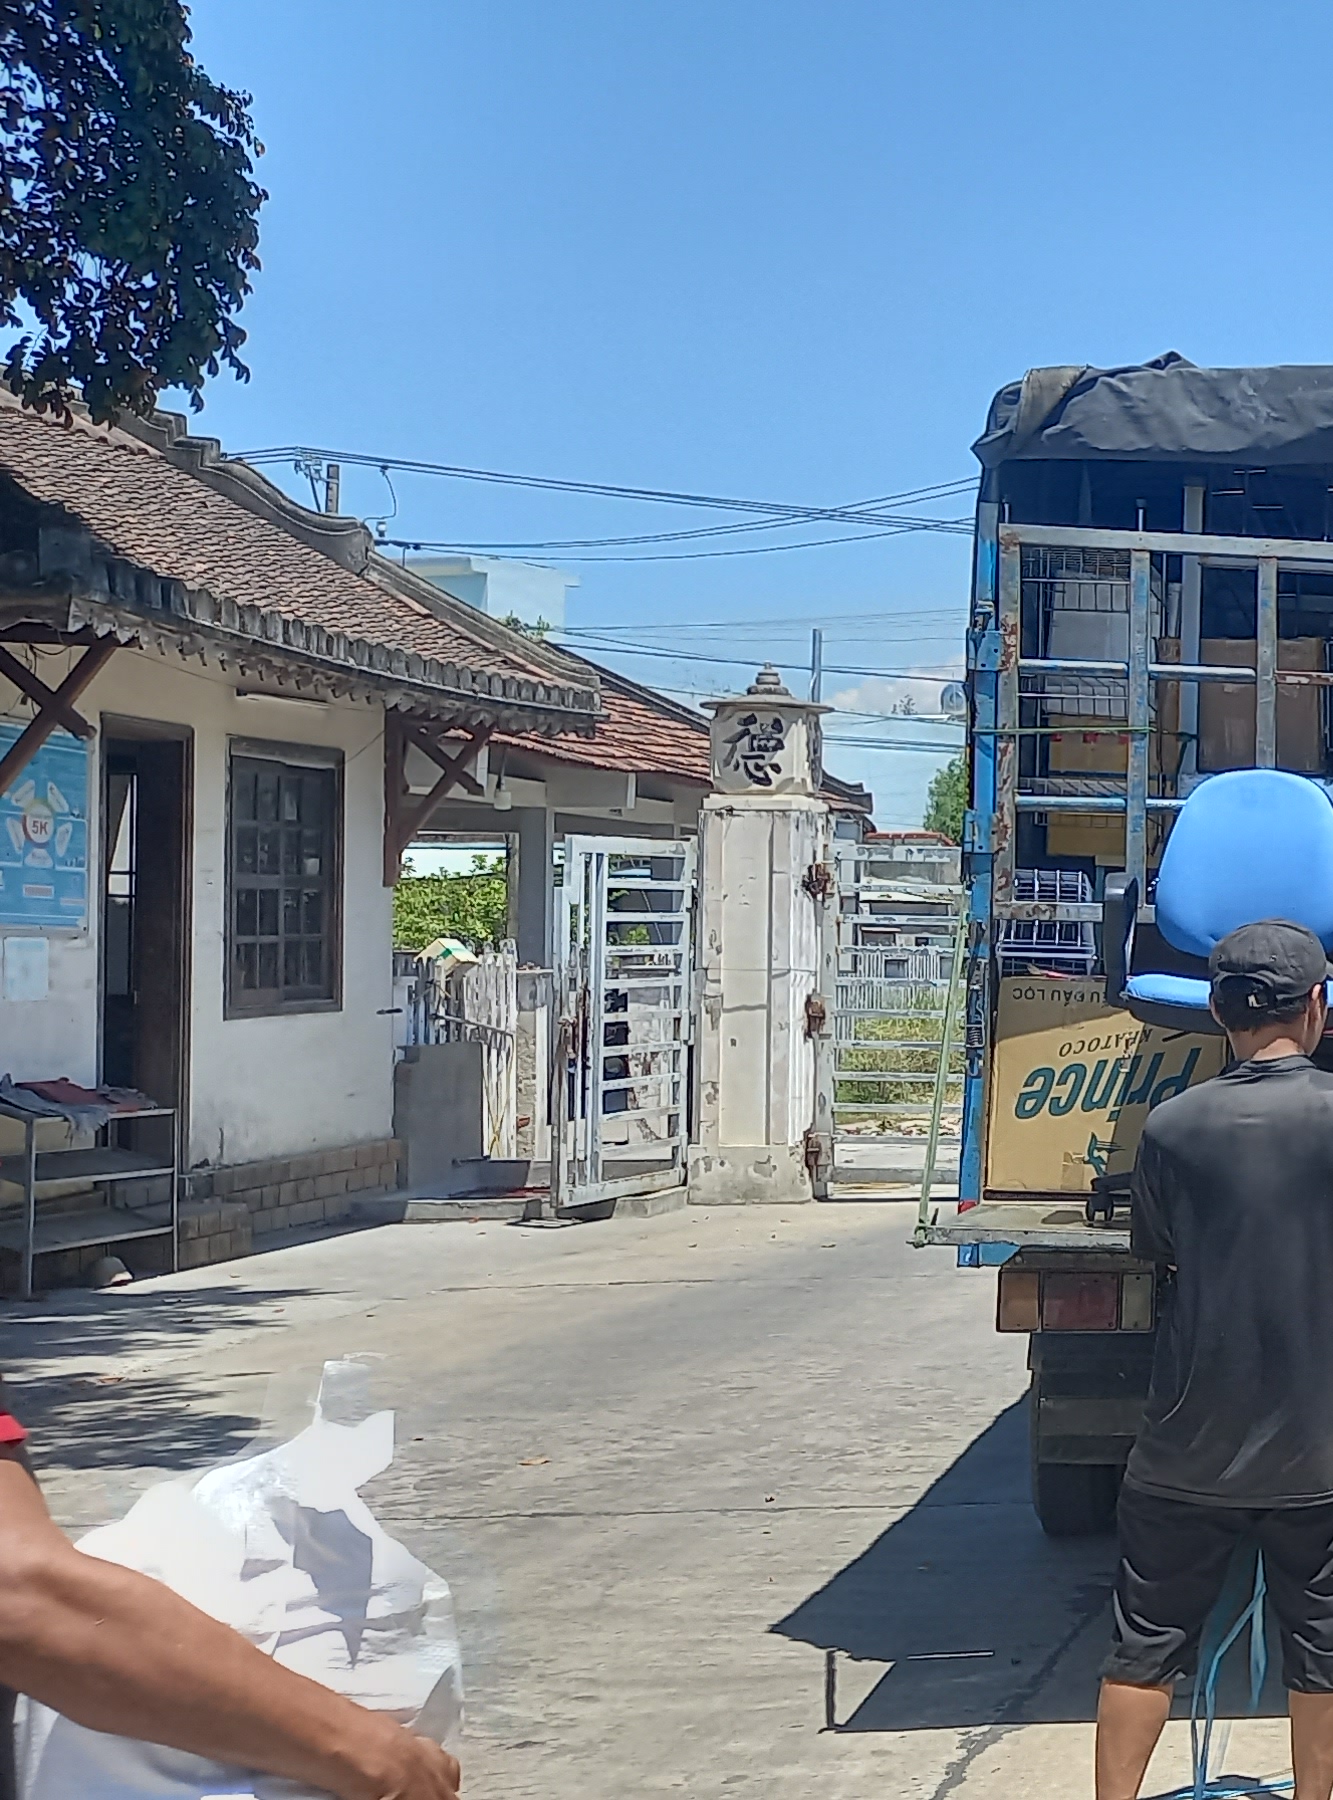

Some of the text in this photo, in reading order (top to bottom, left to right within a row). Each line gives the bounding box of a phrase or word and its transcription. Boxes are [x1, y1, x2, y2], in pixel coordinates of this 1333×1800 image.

[31, 818, 48, 837] 5K
[1012, 986, 1046, 1001] LỌC
[1014, 1047, 1202, 1123] Prince
